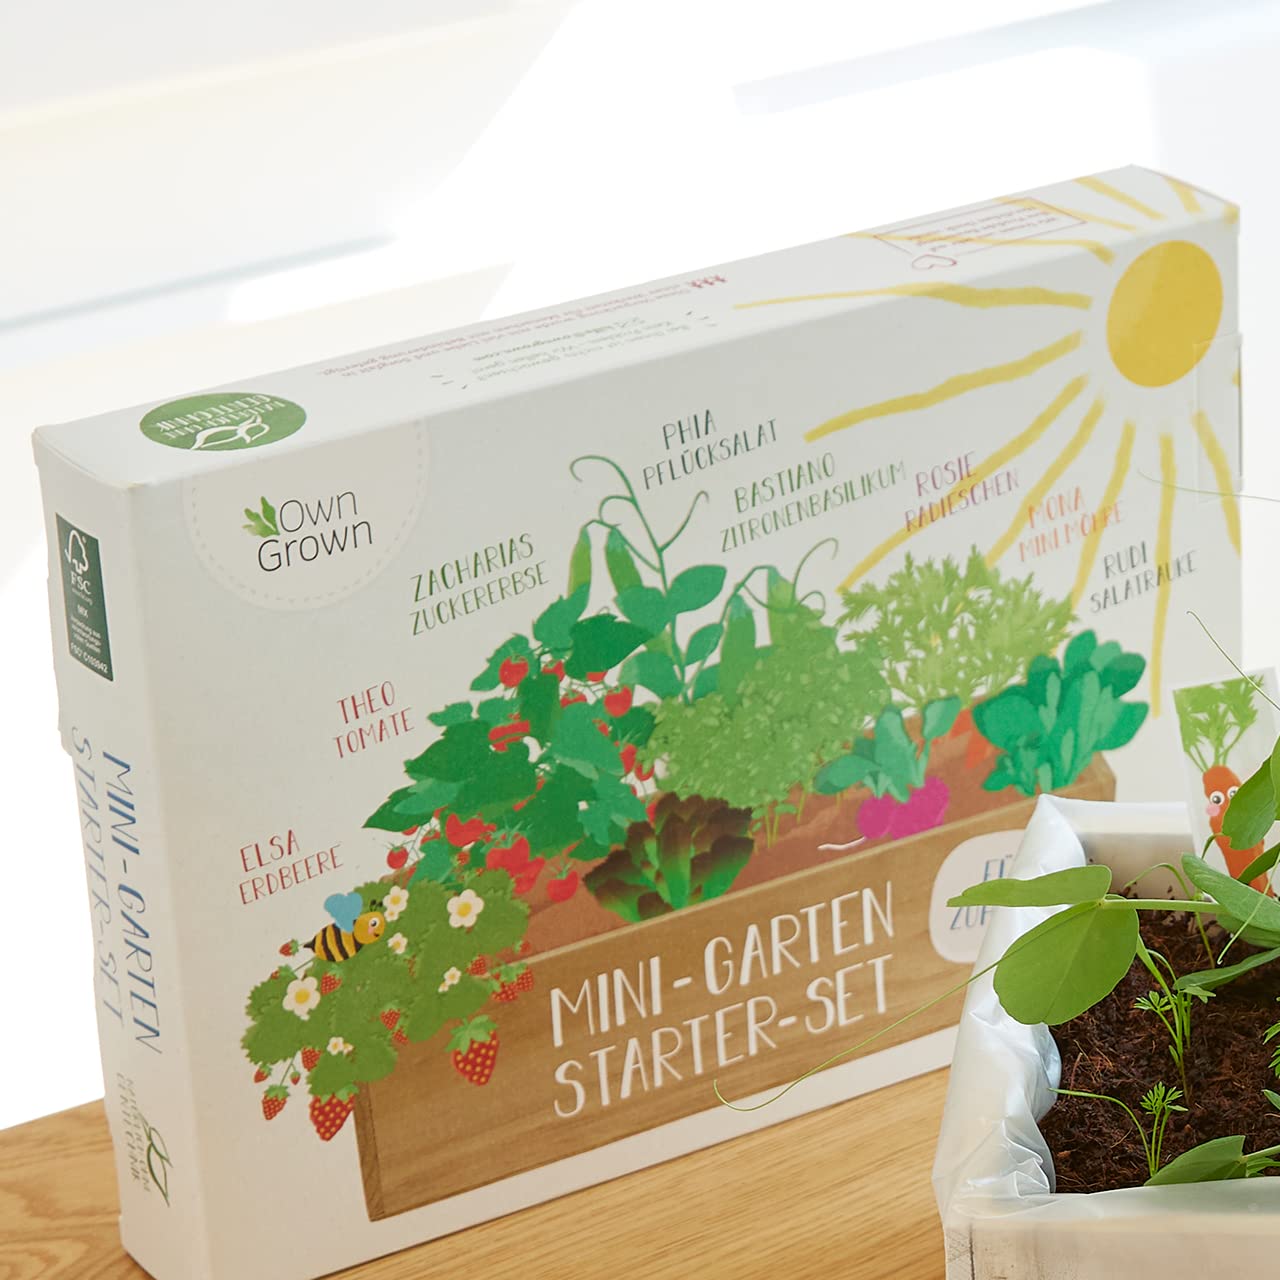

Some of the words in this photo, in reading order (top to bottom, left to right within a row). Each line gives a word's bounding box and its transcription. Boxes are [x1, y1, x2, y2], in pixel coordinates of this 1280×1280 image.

[642, 418, 778, 490] PFLÜCKSALAT
[662, 408, 718, 450] PHIA
[733, 452, 836, 513] BASTIANO
[904, 467, 1020, 532] RADIESCHEN
[915, 451, 978, 497] ROSIE
[279, 491, 358, 533] Own
[720, 460, 907, 552] ZITRONENBASILIKUM
[257, 521, 373, 572] Grown
[410, 533, 535, 603] ZACHARIAS
[1103, 541, 1147, 579] RUDI
[409, 560, 550, 637] ZUCKERERBSE
[1090, 550, 1198, 613] SALATRAUKE
[333, 707, 415, 758] TOMATE
[337, 681, 396, 724] THEO
[239, 841, 344, 905] ERDBEERE
[240, 829, 300, 872] ELSA
[553, 953, 893, 1118] STARTER-SET
